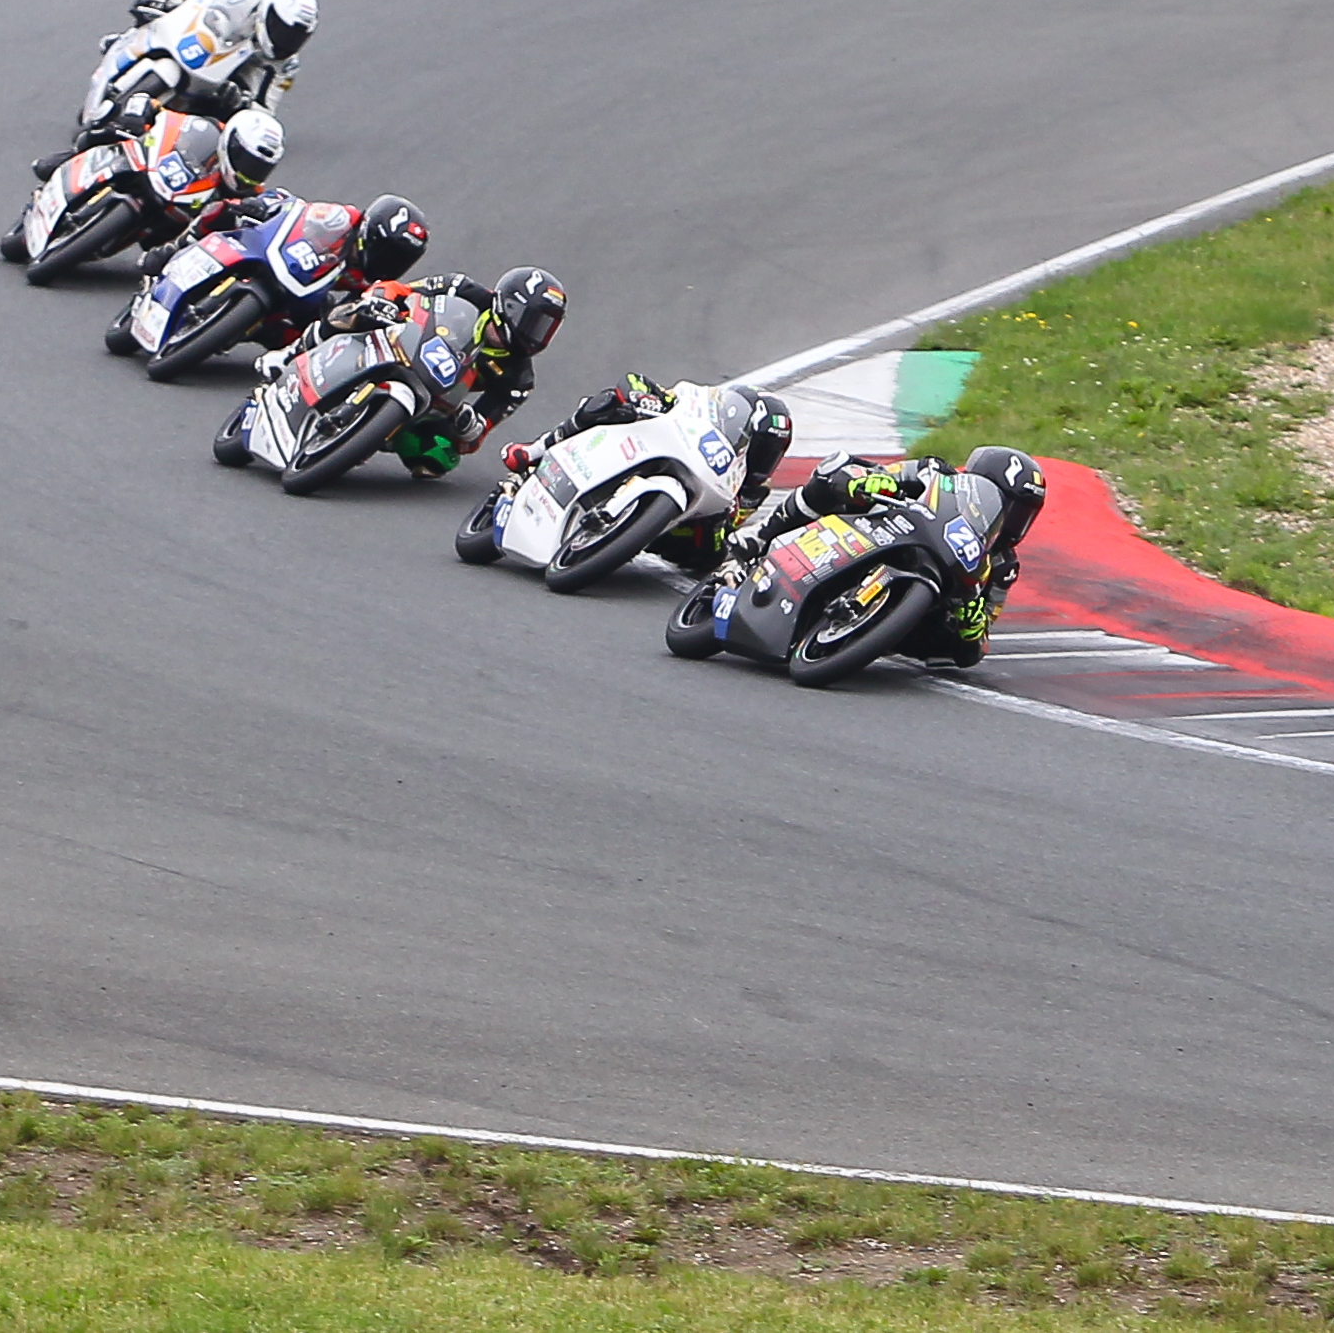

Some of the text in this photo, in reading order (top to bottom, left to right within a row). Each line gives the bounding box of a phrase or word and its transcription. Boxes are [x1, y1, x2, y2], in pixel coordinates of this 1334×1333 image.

[180, 42, 205, 61] 5
[286, 240, 320, 271] 85
[425, 345, 457, 379] 20
[702, 440, 732, 469] 46
[947, 525, 981, 562] 28
[714, 592, 736, 619] 28
